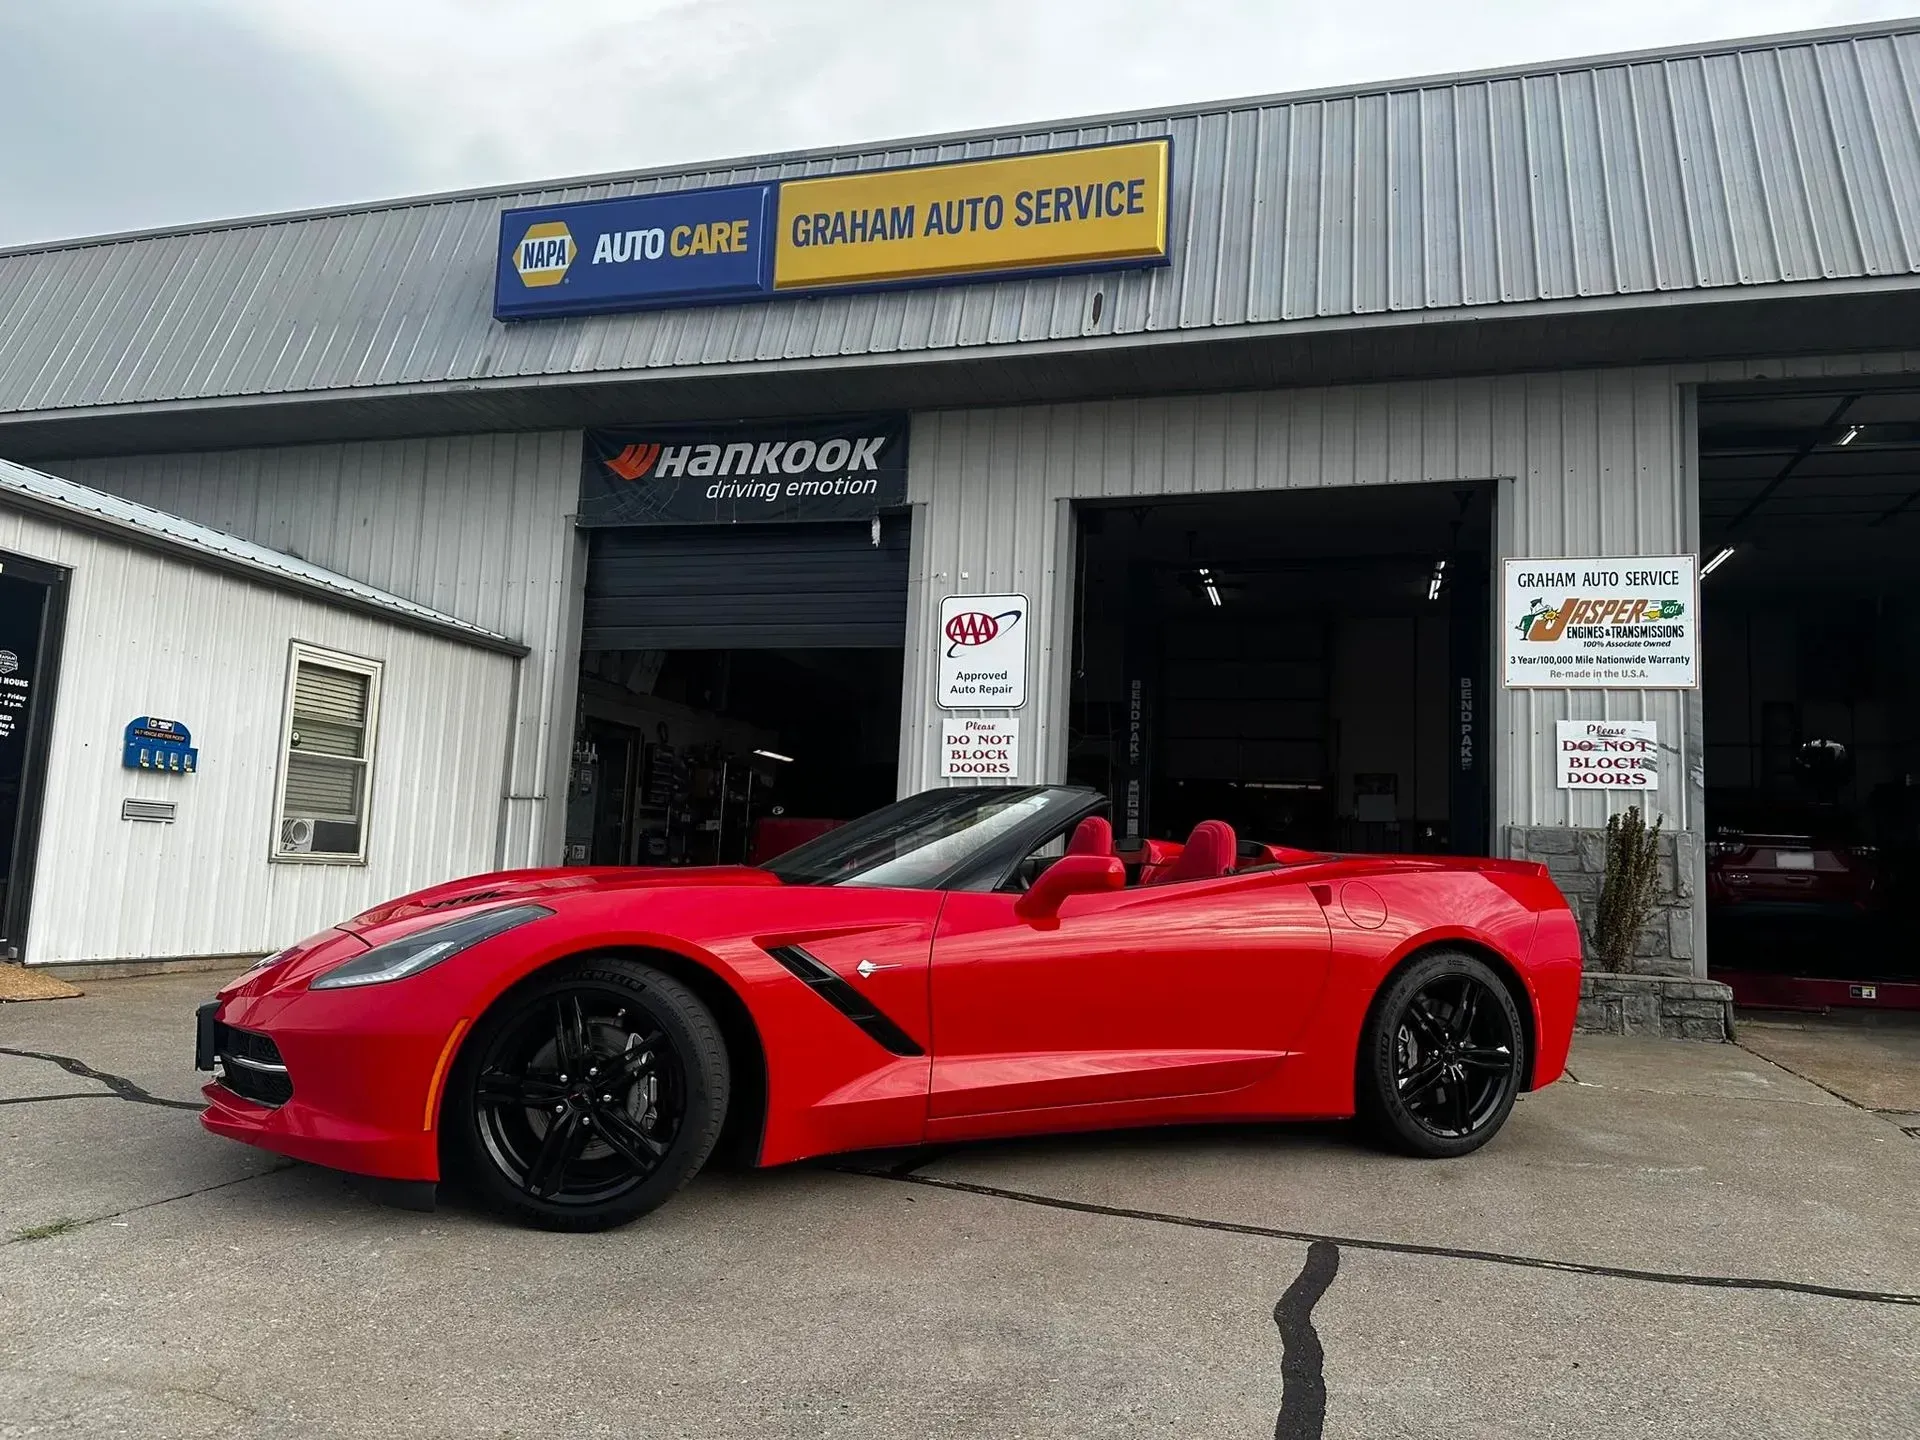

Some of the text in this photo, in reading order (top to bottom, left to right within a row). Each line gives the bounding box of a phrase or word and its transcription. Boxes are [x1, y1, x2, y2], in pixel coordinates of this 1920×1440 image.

[791, 178, 1146, 248] GRAHAM AUTO SERVICE
[592, 219, 748, 265] AUTO CARE
[519, 238, 570, 271] NAPA
[705, 476, 879, 503] driving emotion
[1517, 570, 1680, 588] GRAHAM AUTO SERVICE
[1528, 597, 1649, 642] JASPER
[952, 613, 993, 645] AAA
[1566, 625, 1605, 640] ENGINES
[1611, 624, 1685, 639] TRANSMISSIONS
[1582, 640, 1672, 648] 100% Associate Owned
[1510, 655, 1691, 666] 3 Year/100,000 Mile Nationwide Warranty
[956, 670, 1008, 683] Approved
[1550, 669, 1649, 679] Re-made in the U.S.A.
[4, 677, 29, 688] HOURS
[950, 684, 1014, 696] Auto Repair
[965, 720, 996, 731] Please
[1586, 723, 1627, 737] Please
[946, 734, 1015, 745] DO NOT
[1562, 740, 1649, 752] DO NOT
[951, 749, 1009, 760] BLOCK
[949, 763, 1010, 774] DOORS
[1568, 756, 1642, 769] BLOCK
[1567, 772, 1647, 785] DOORS
